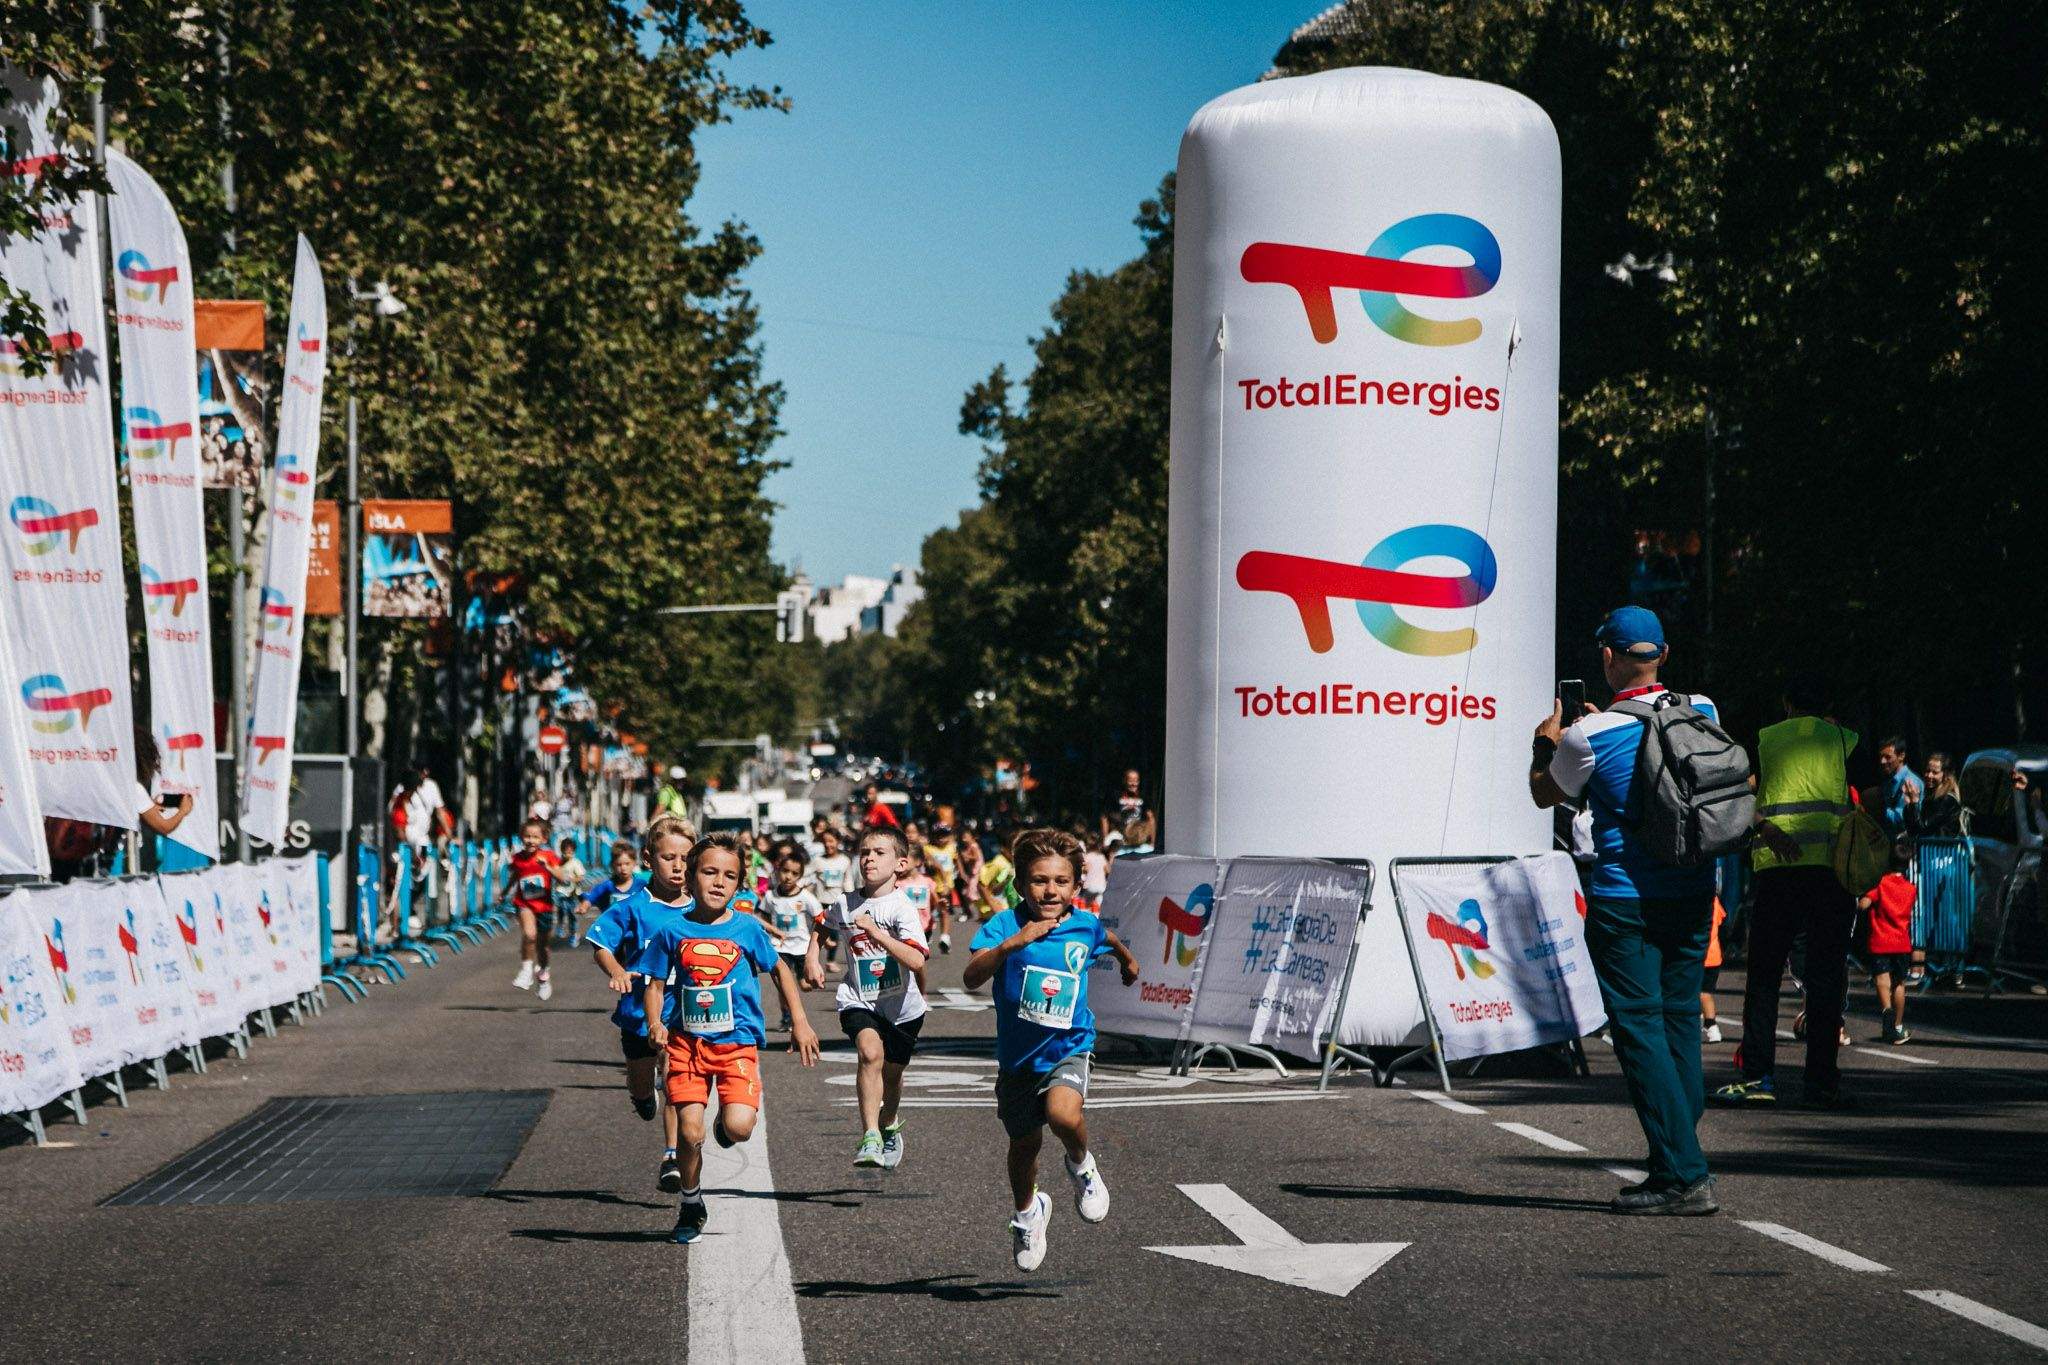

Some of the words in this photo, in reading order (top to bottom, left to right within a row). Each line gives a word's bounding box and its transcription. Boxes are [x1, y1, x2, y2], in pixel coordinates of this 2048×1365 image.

[1238, 374, 1500, 416] TotalEnergies
[1234, 684, 1497, 726] TotalEnergies
[1449, 998, 1514, 1023] TotalEnergies
